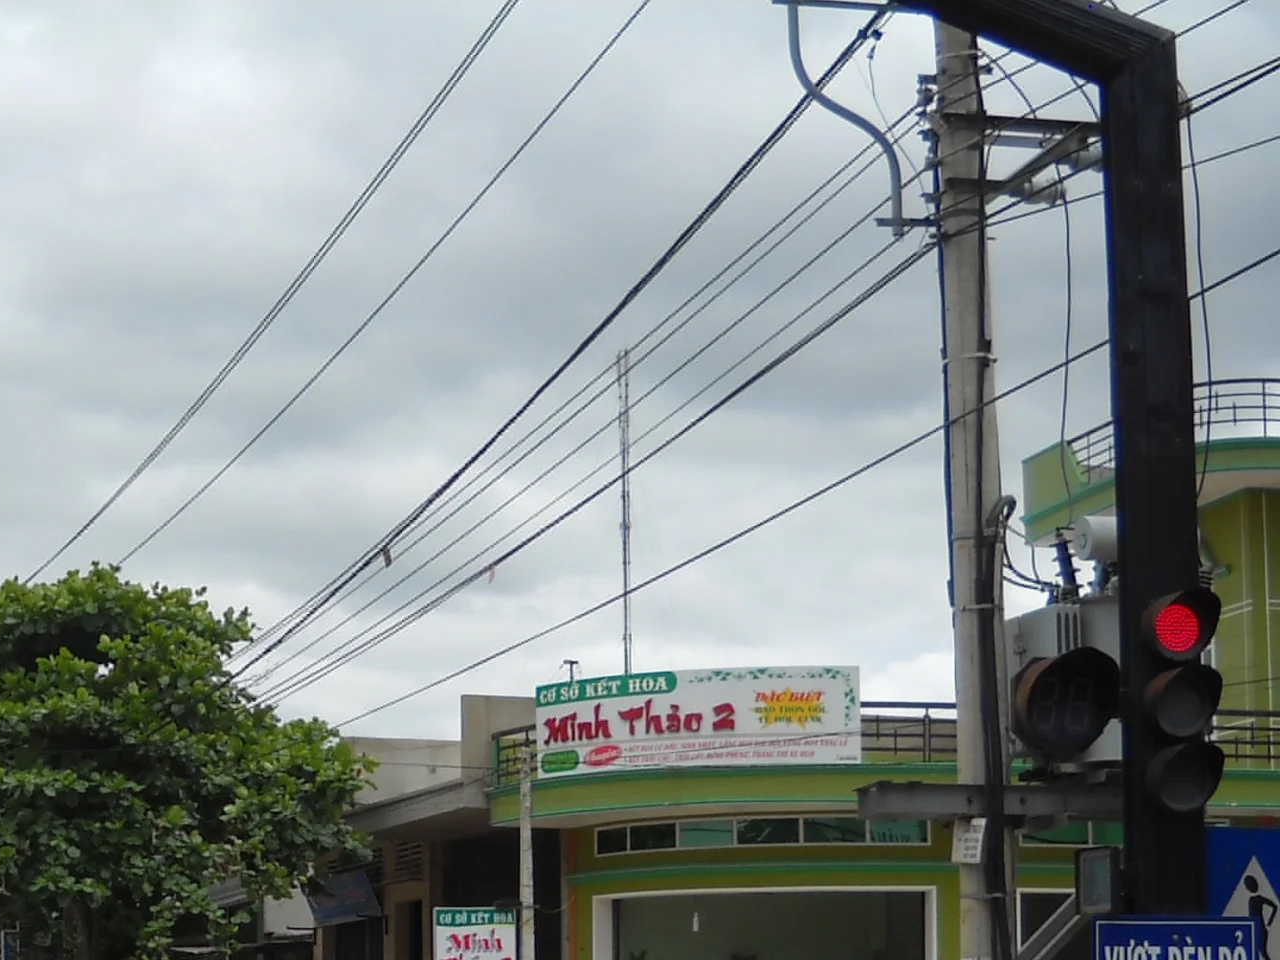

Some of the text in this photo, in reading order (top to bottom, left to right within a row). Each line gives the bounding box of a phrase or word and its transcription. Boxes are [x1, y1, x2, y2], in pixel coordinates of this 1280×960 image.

[540, 676, 668, 704] CƠ SỞ KẾT HOA
[543, 698, 736, 746] Minh Thảo 2
[446, 928, 503, 953] Minh
